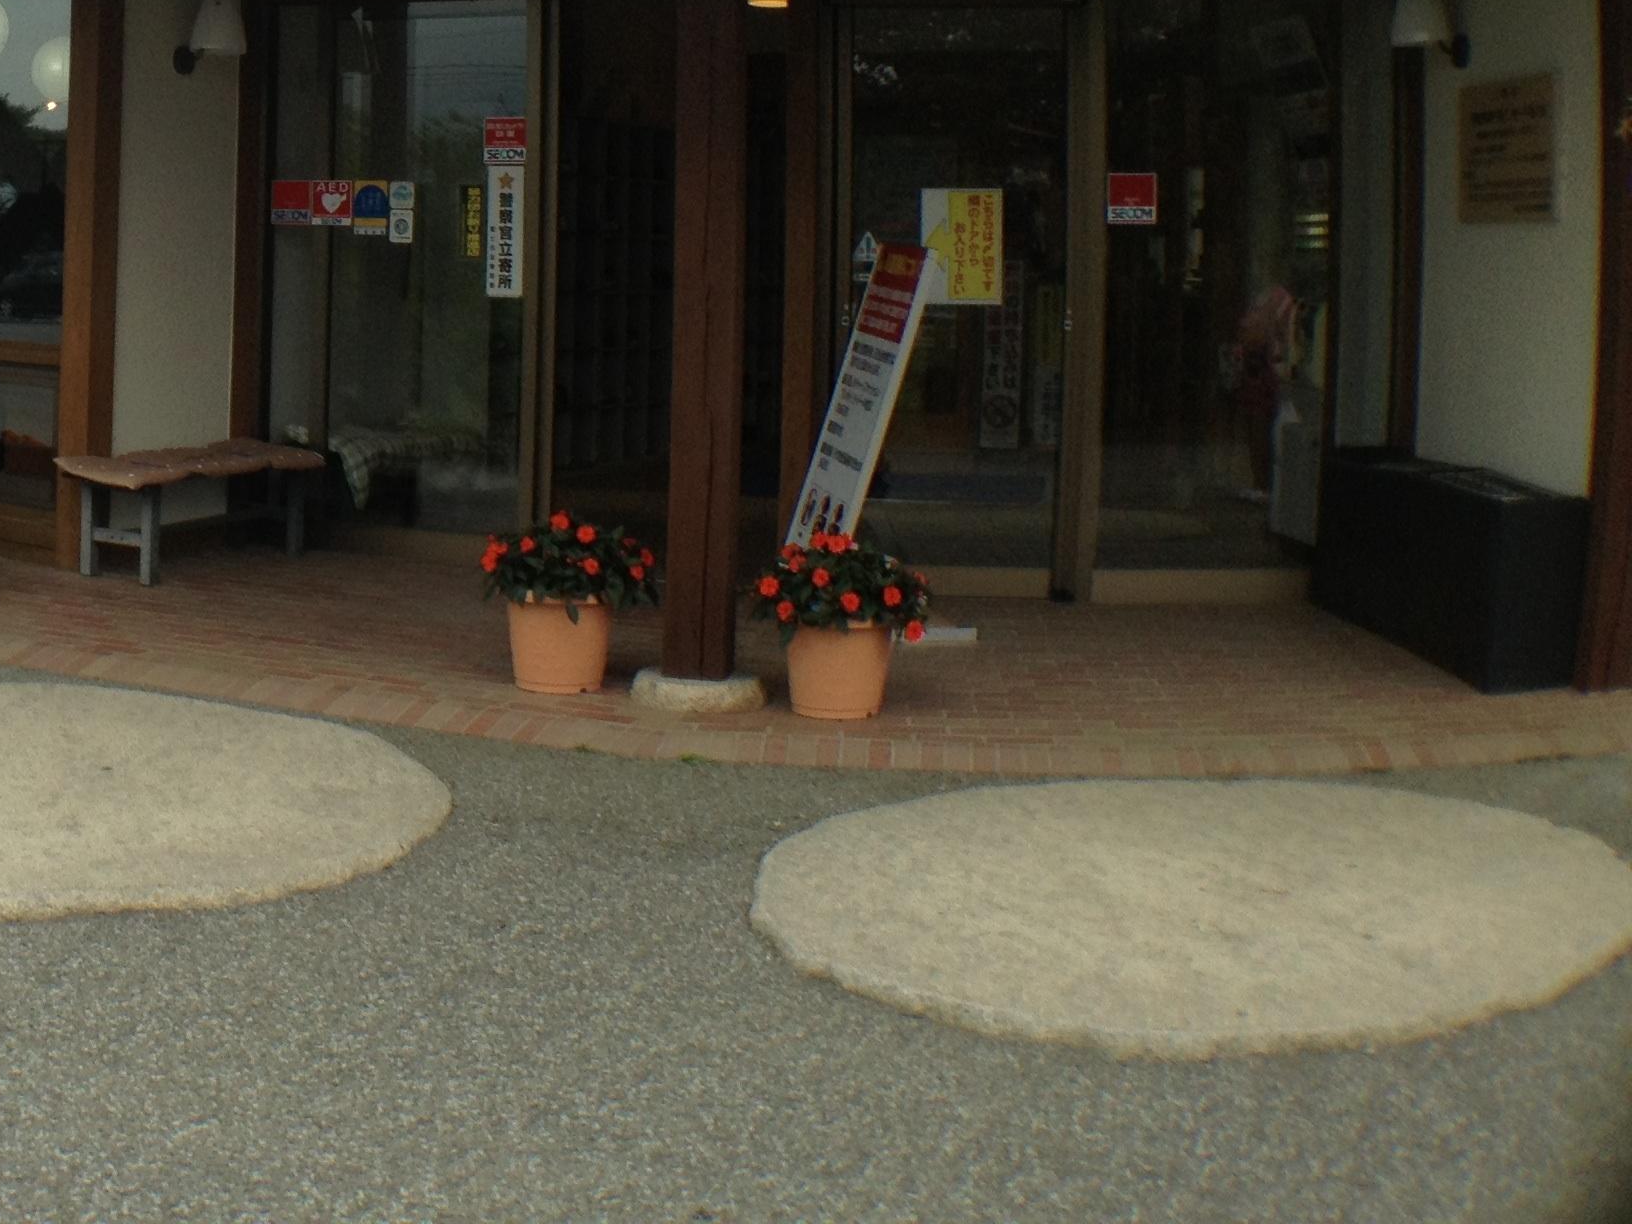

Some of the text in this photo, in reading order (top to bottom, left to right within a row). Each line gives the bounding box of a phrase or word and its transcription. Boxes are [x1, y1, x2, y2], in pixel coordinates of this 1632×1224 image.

[486, 149, 525, 160] SECOM
[316, 182, 349, 193] AED
[1111, 208, 1153, 219] SECOM
[497, 192, 514, 289] 警察官立寄所
